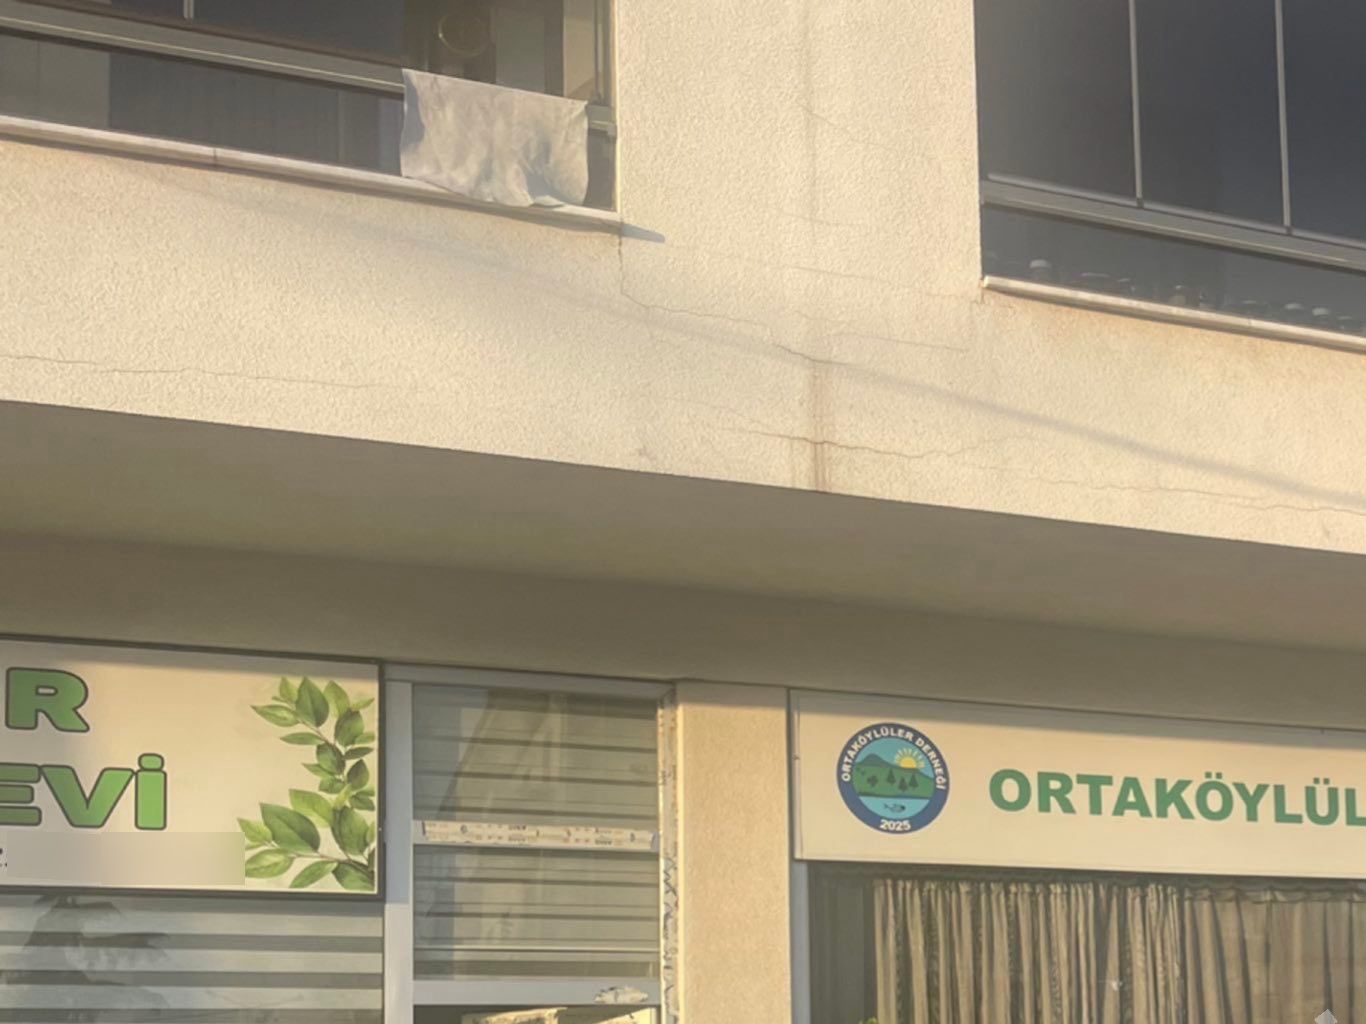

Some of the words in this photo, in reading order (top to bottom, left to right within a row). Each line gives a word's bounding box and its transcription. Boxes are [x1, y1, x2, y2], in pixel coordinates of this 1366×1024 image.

[5, 667, 90, 733] R
[841, 726, 914, 782] ORTAKÖYLÜLER
[880, 818, 912, 832] 2025
